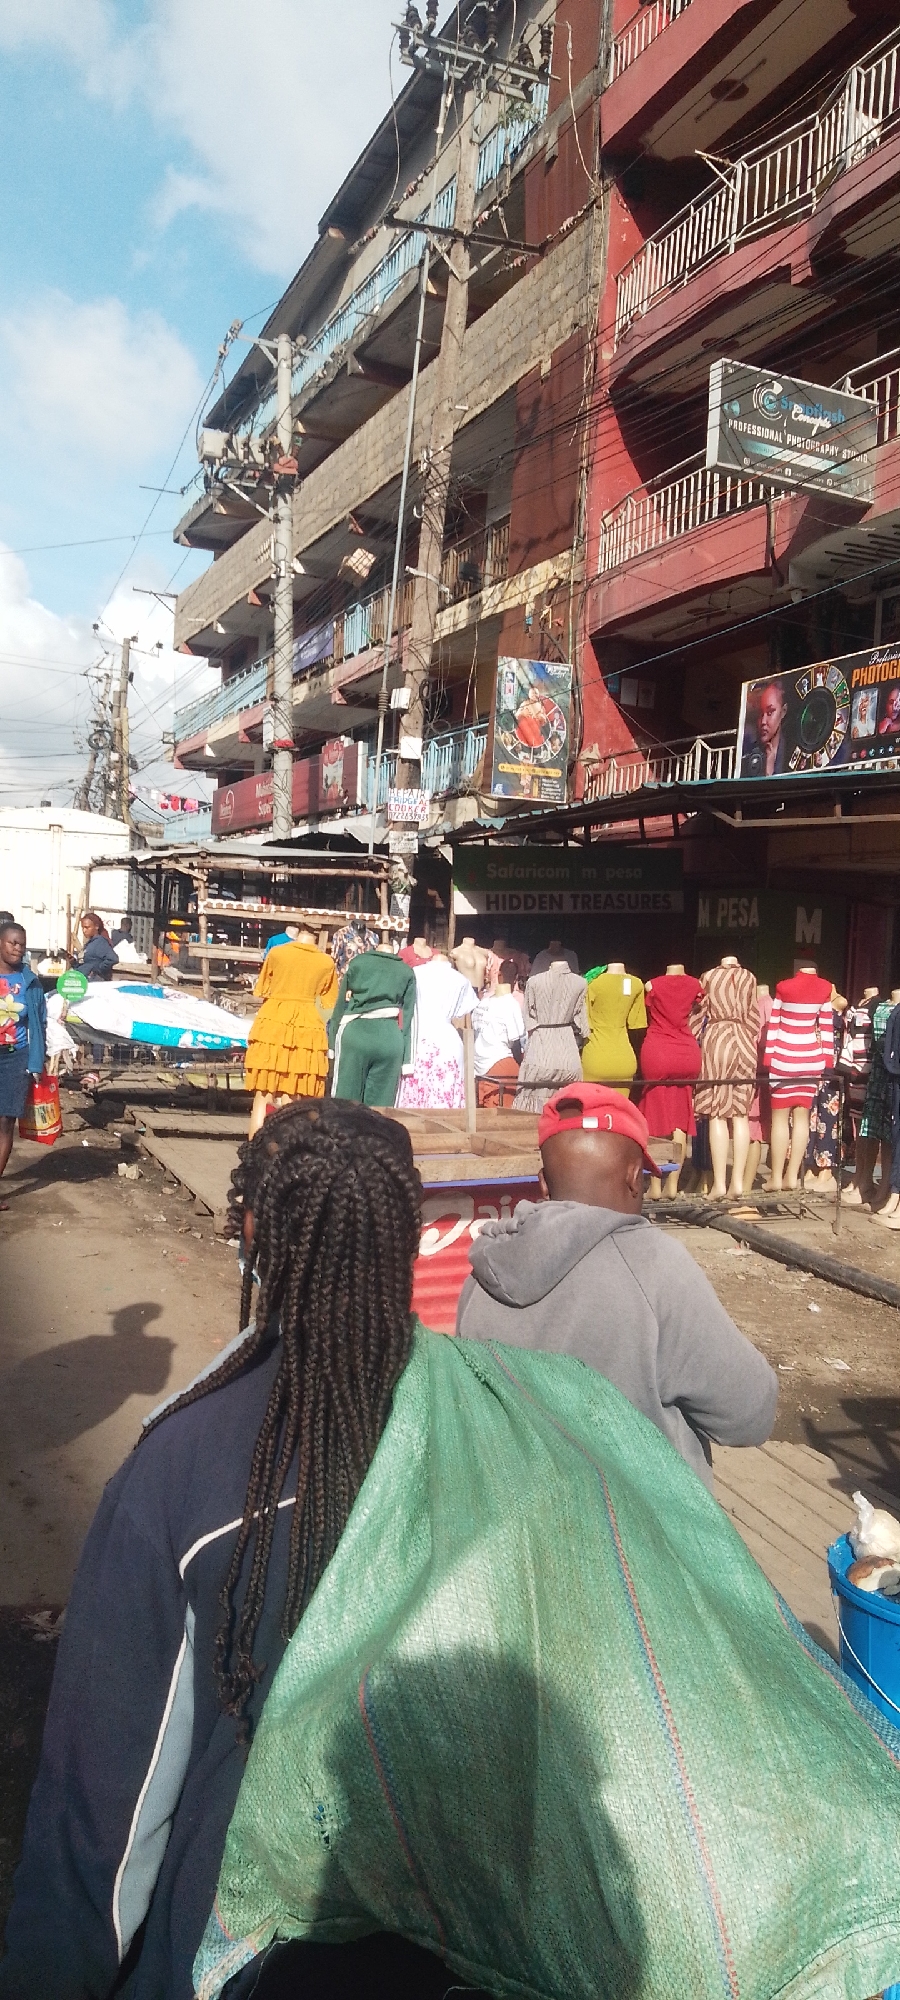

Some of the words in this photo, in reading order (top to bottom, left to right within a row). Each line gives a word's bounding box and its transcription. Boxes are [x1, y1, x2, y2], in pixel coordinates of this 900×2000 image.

[728, 418, 783, 444] PROFESSIONAL
[786, 433, 839, 457] PHOTOGRAPHY
[842, 448, 868, 464] STUDIO
[486, 862, 570, 879] Safaricom
[606, 866, 643, 881] pesa
[485, 893, 564, 911] HIDDEN
[570, 893, 672, 911] TREASURES
[716, 897, 760, 928] PESA
